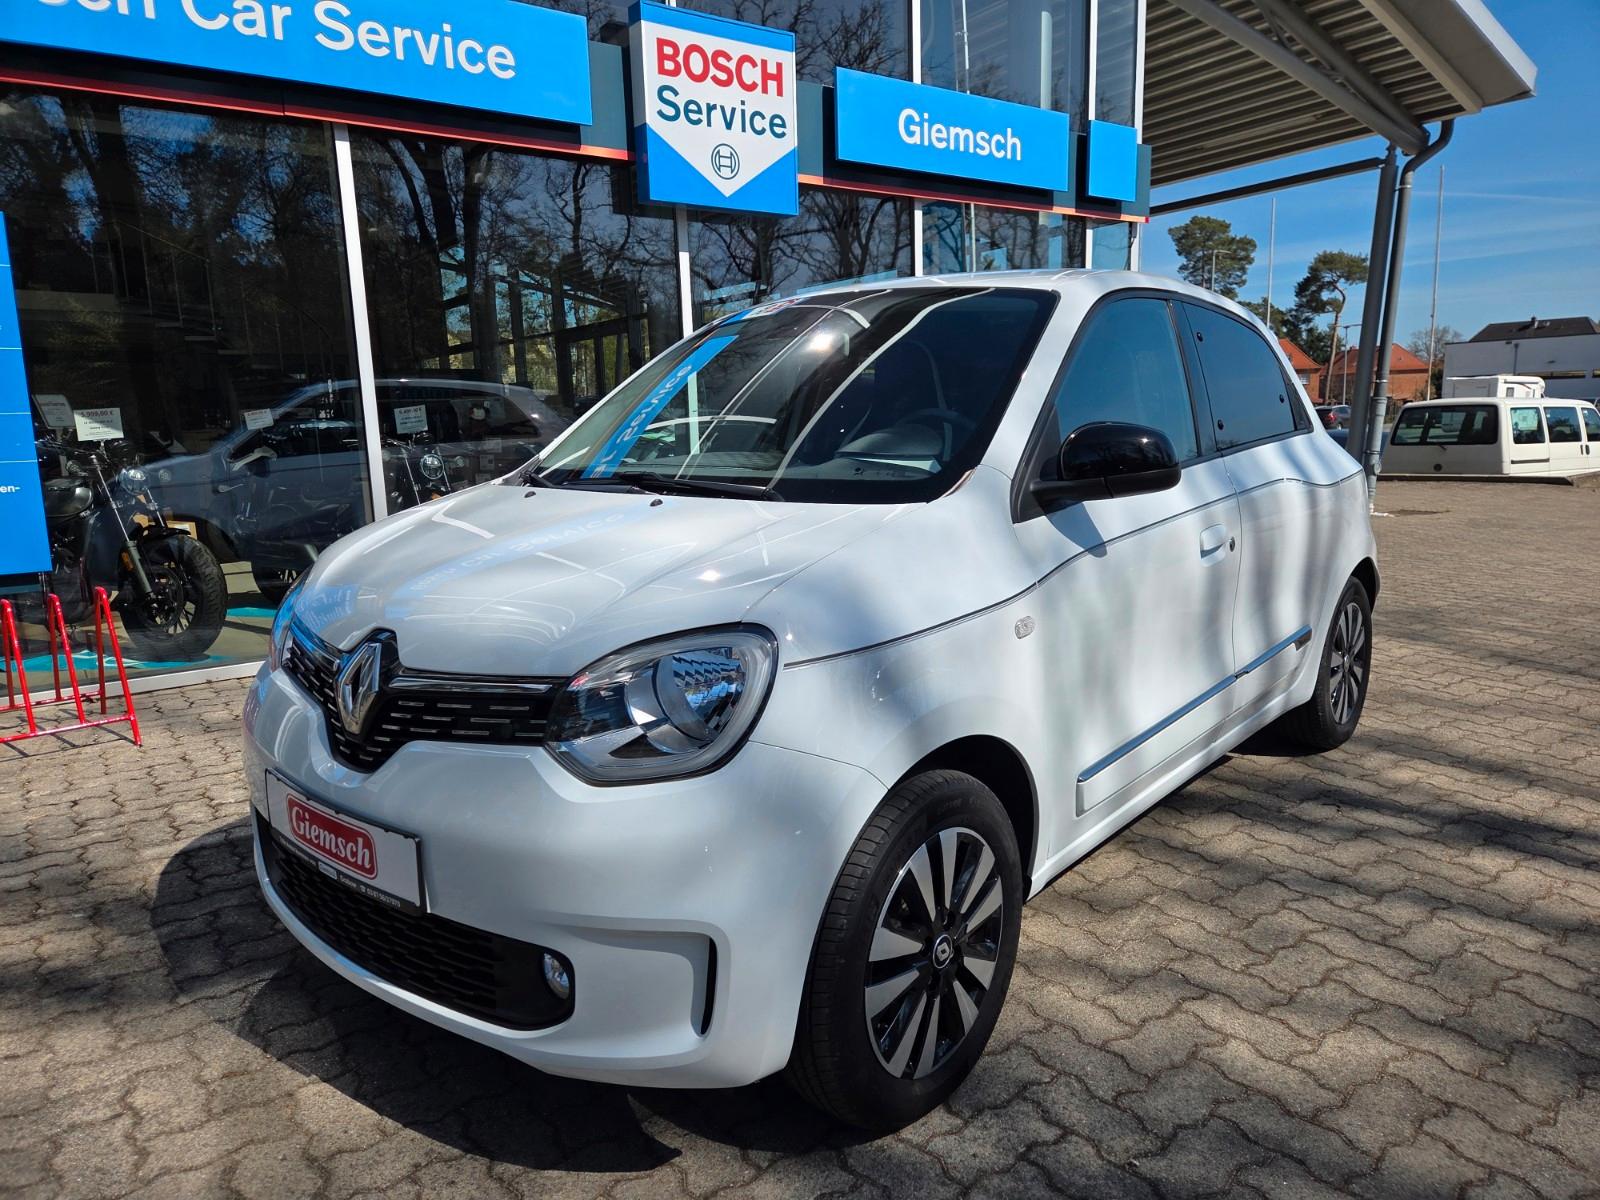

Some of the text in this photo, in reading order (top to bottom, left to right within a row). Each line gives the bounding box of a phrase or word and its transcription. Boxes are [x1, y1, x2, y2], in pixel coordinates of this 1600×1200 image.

[181, 0, 516, 79] Car Service
[656, 36, 784, 97] BOSCH
[656, 84, 788, 139] Service
[898, 108, 1021, 161] Giemsch
[291, 805, 372, 869] Giemsch
